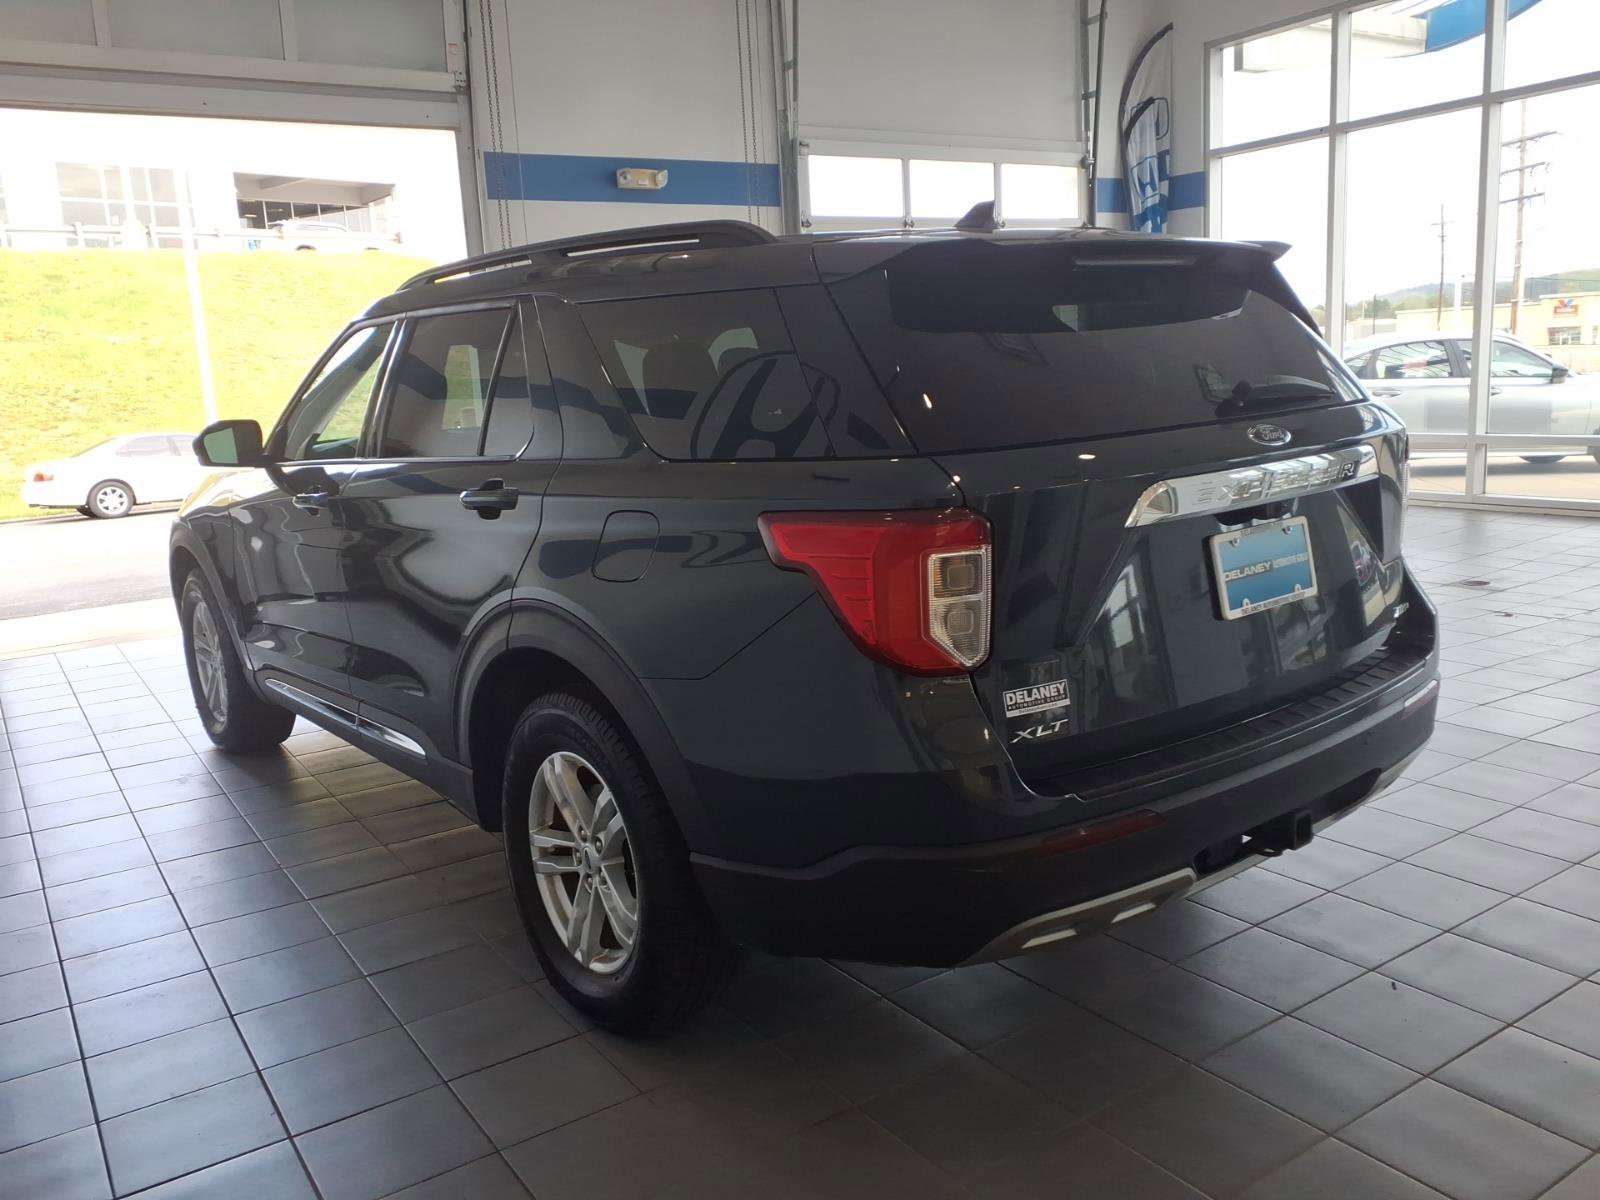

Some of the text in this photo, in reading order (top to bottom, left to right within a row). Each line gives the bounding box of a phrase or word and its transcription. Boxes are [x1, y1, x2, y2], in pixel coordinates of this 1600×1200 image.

[1196, 459, 1360, 506] EXPLR
[1224, 561, 1271, 581] DELANEY
[1005, 681, 1066, 706] DELANEY
[1010, 718, 1069, 743] XLT
